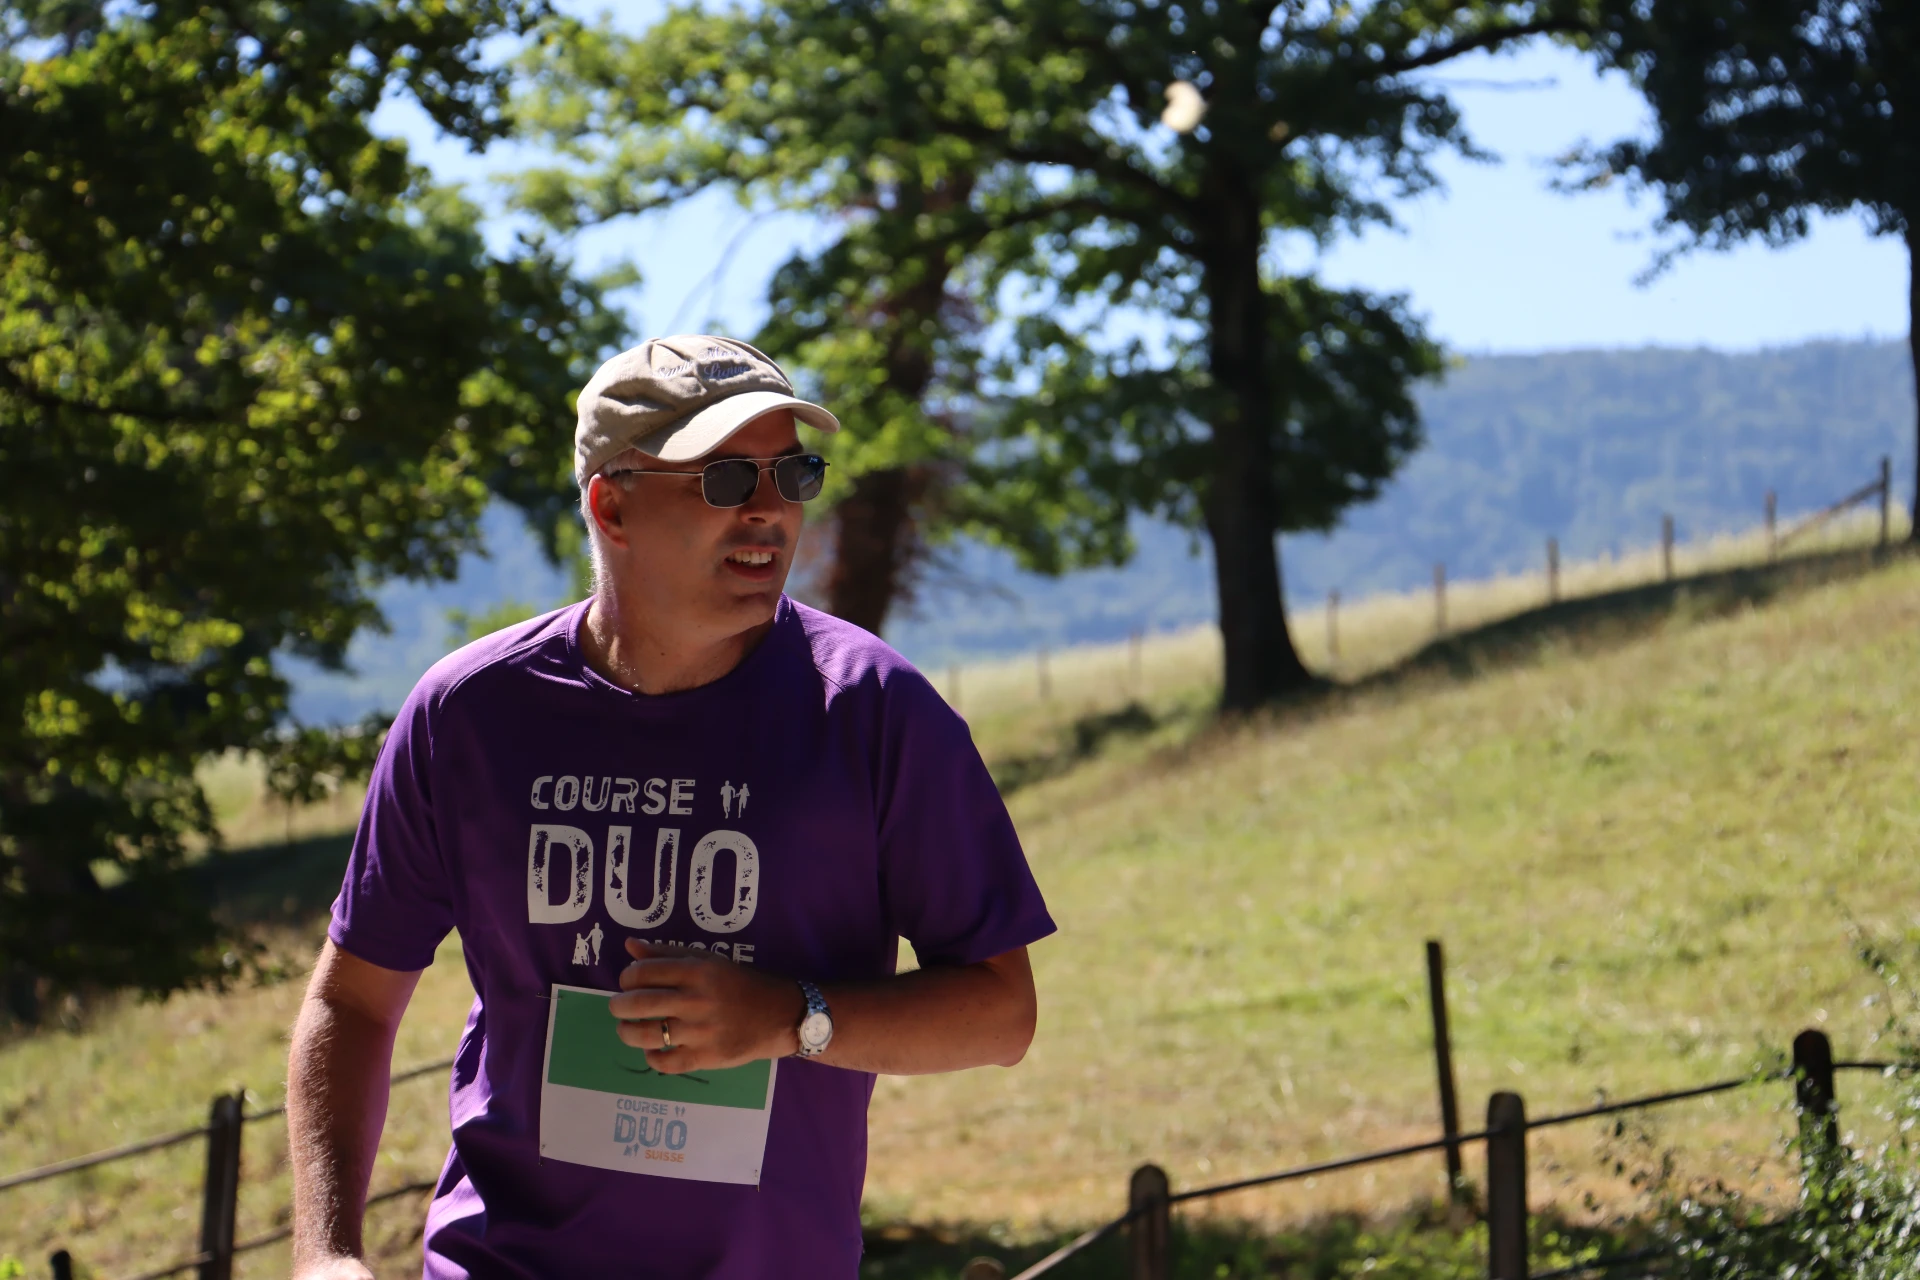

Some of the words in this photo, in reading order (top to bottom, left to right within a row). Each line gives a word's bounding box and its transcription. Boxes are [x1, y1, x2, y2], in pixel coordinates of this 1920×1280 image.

[530, 775, 696, 815] COURSE
[527, 823, 760, 934] DUO
[616, 1098, 668, 1115] COURSE
[613, 1113, 687, 1150] DUO
[645, 1150, 684, 1163] SUISSE
